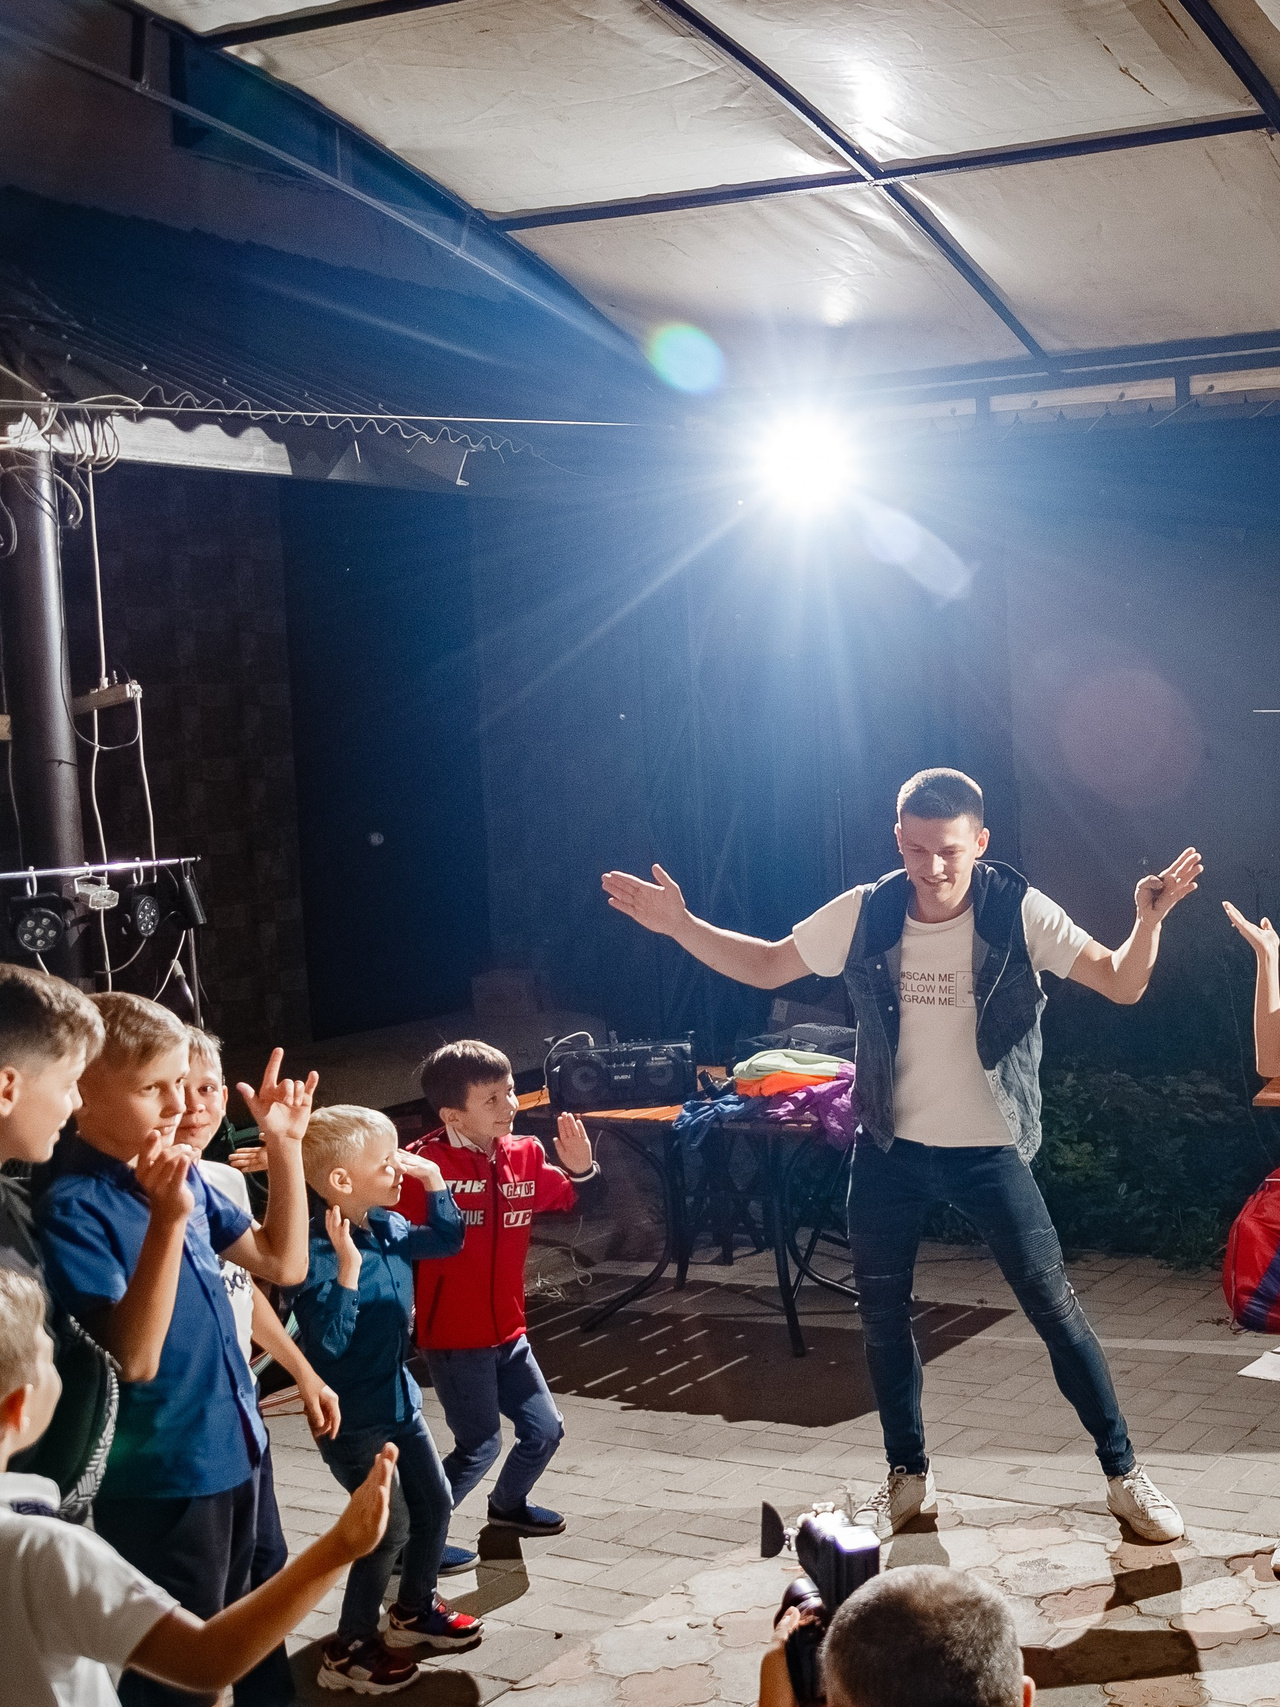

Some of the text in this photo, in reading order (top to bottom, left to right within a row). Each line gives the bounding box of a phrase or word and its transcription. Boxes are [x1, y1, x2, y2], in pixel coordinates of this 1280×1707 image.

[900, 971, 955, 983] #SCAN ME
[899, 982, 935, 993] OLLOW
[938, 984, 955, 995] ME
[938, 996, 955, 1006] ME
[505, 1211, 532, 1226] UP
